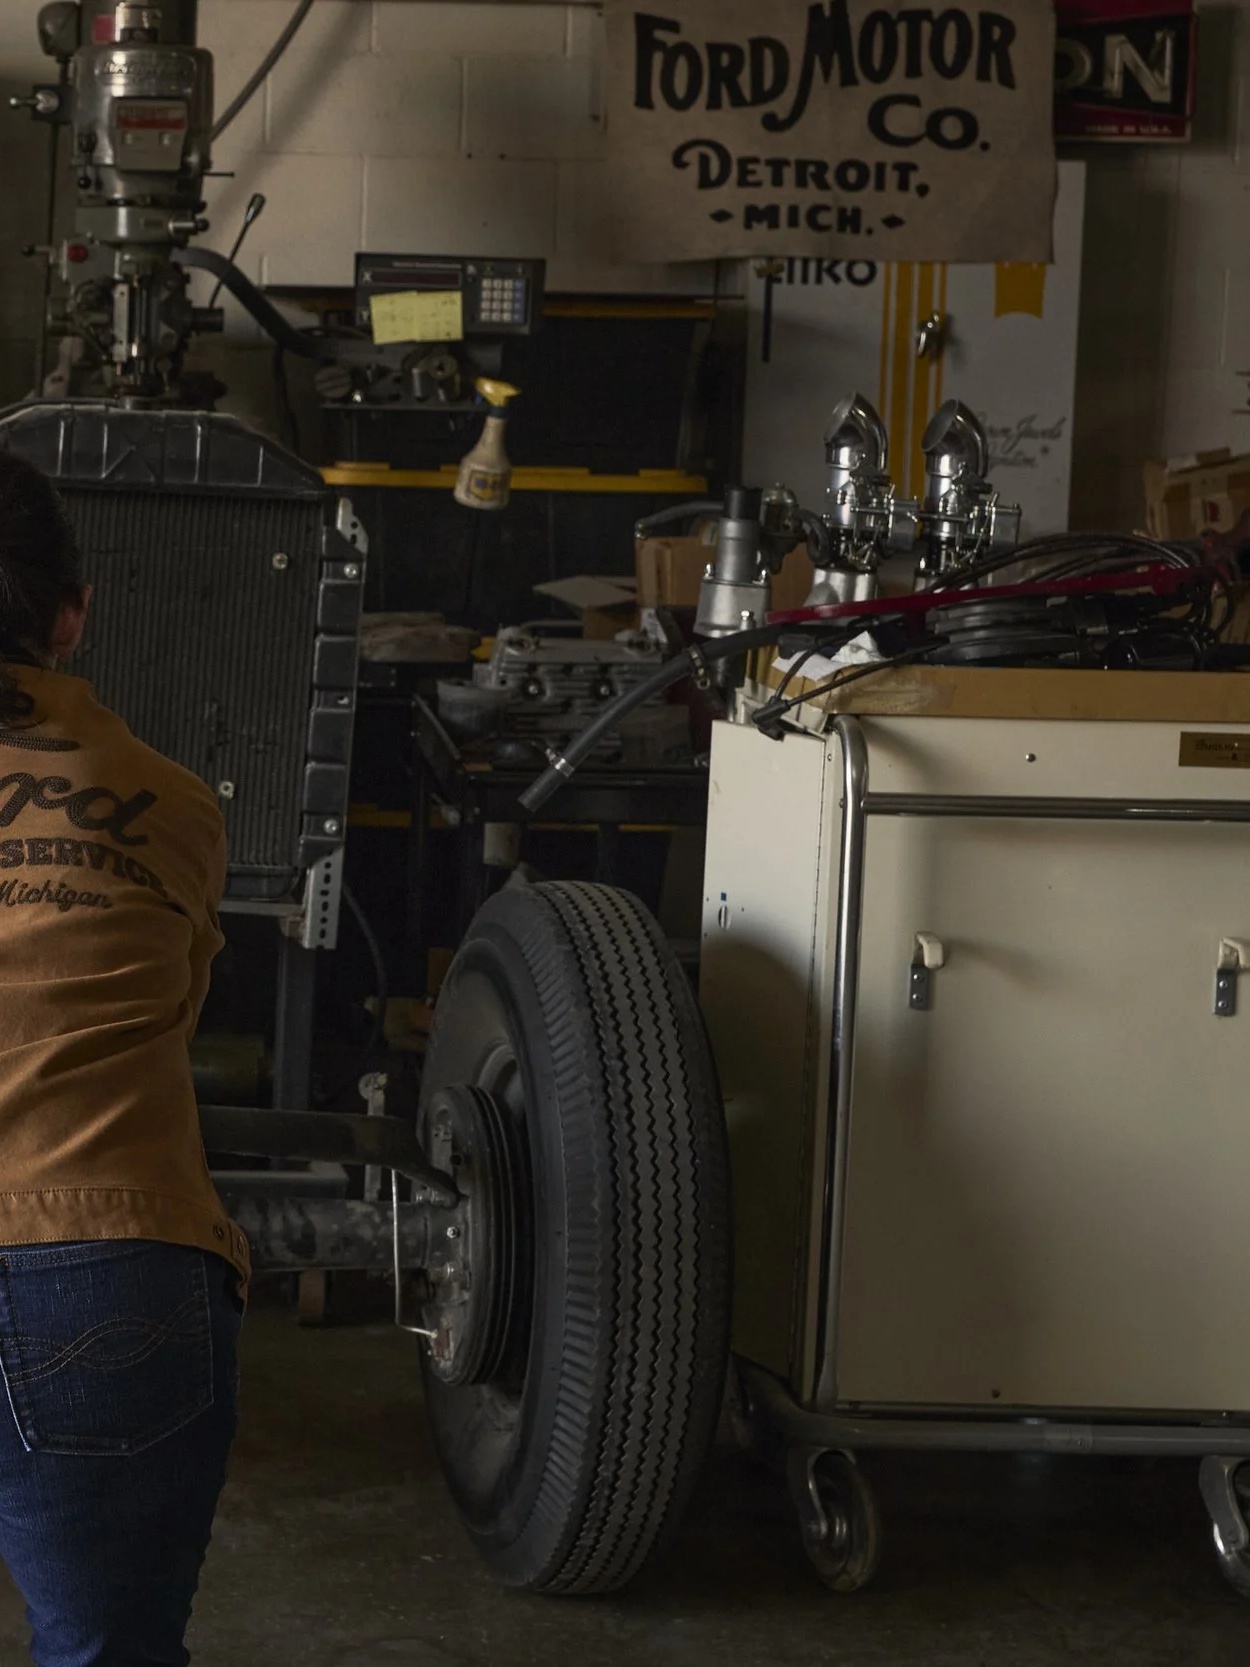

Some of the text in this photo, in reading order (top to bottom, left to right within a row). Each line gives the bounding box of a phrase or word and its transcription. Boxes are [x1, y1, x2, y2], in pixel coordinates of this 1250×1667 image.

[634, 0, 1017, 132] FORD MOTOR
[743, 203, 874, 235] MICH.
